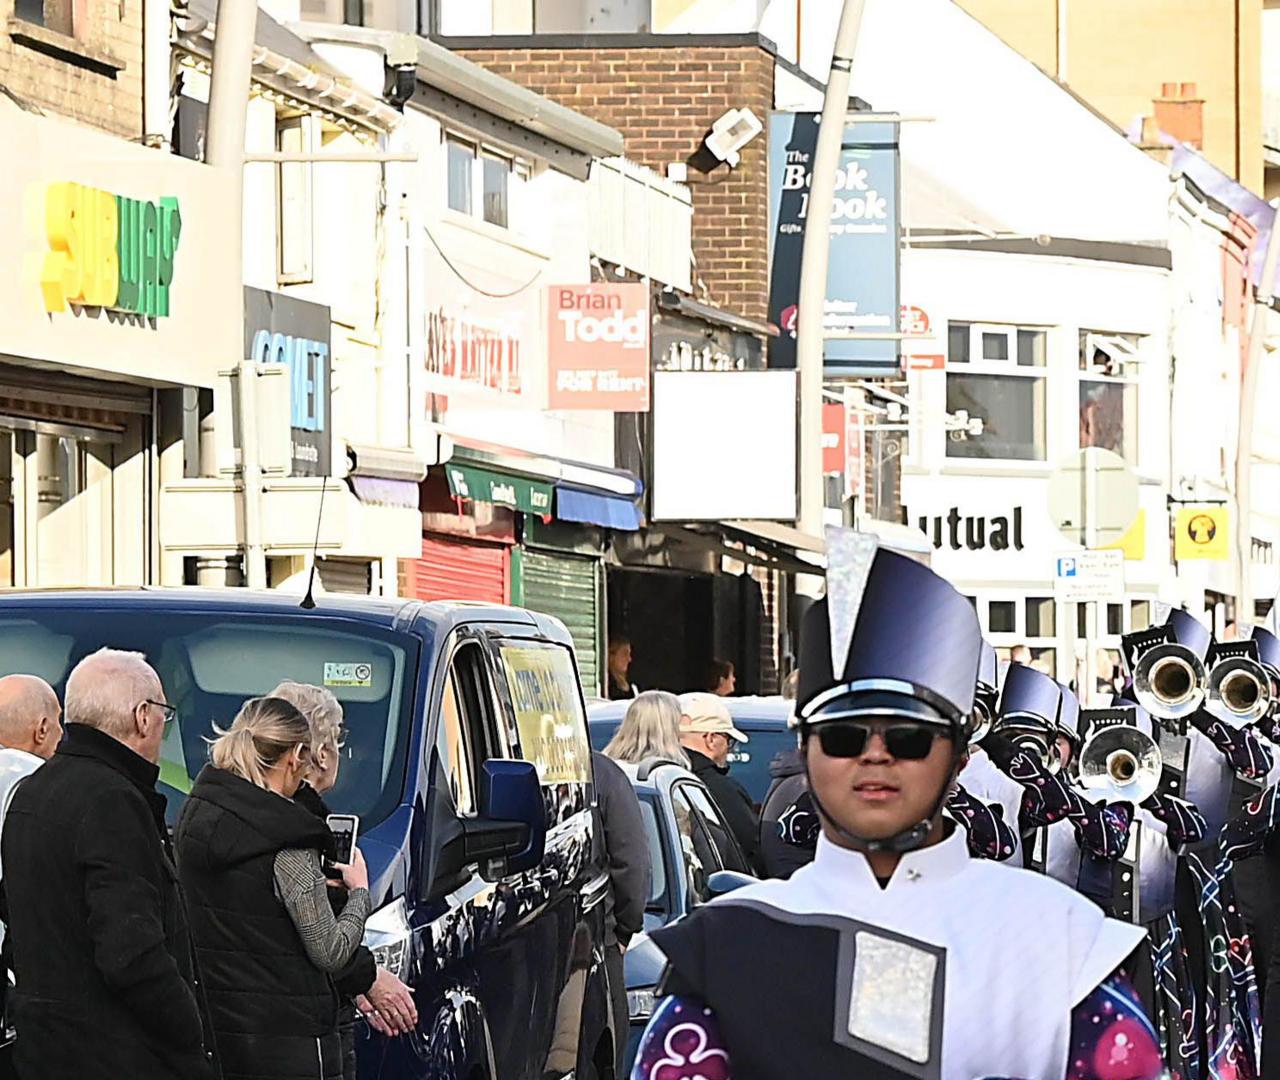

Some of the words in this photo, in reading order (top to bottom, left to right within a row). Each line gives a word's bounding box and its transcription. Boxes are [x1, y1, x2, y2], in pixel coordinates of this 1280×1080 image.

[787, 151, 809, 162] The
[782, 162, 868, 190] Bok
[559, 289, 622, 310] Brian
[557, 309, 646, 343] Todd
[901, 505, 1025, 552] utual
